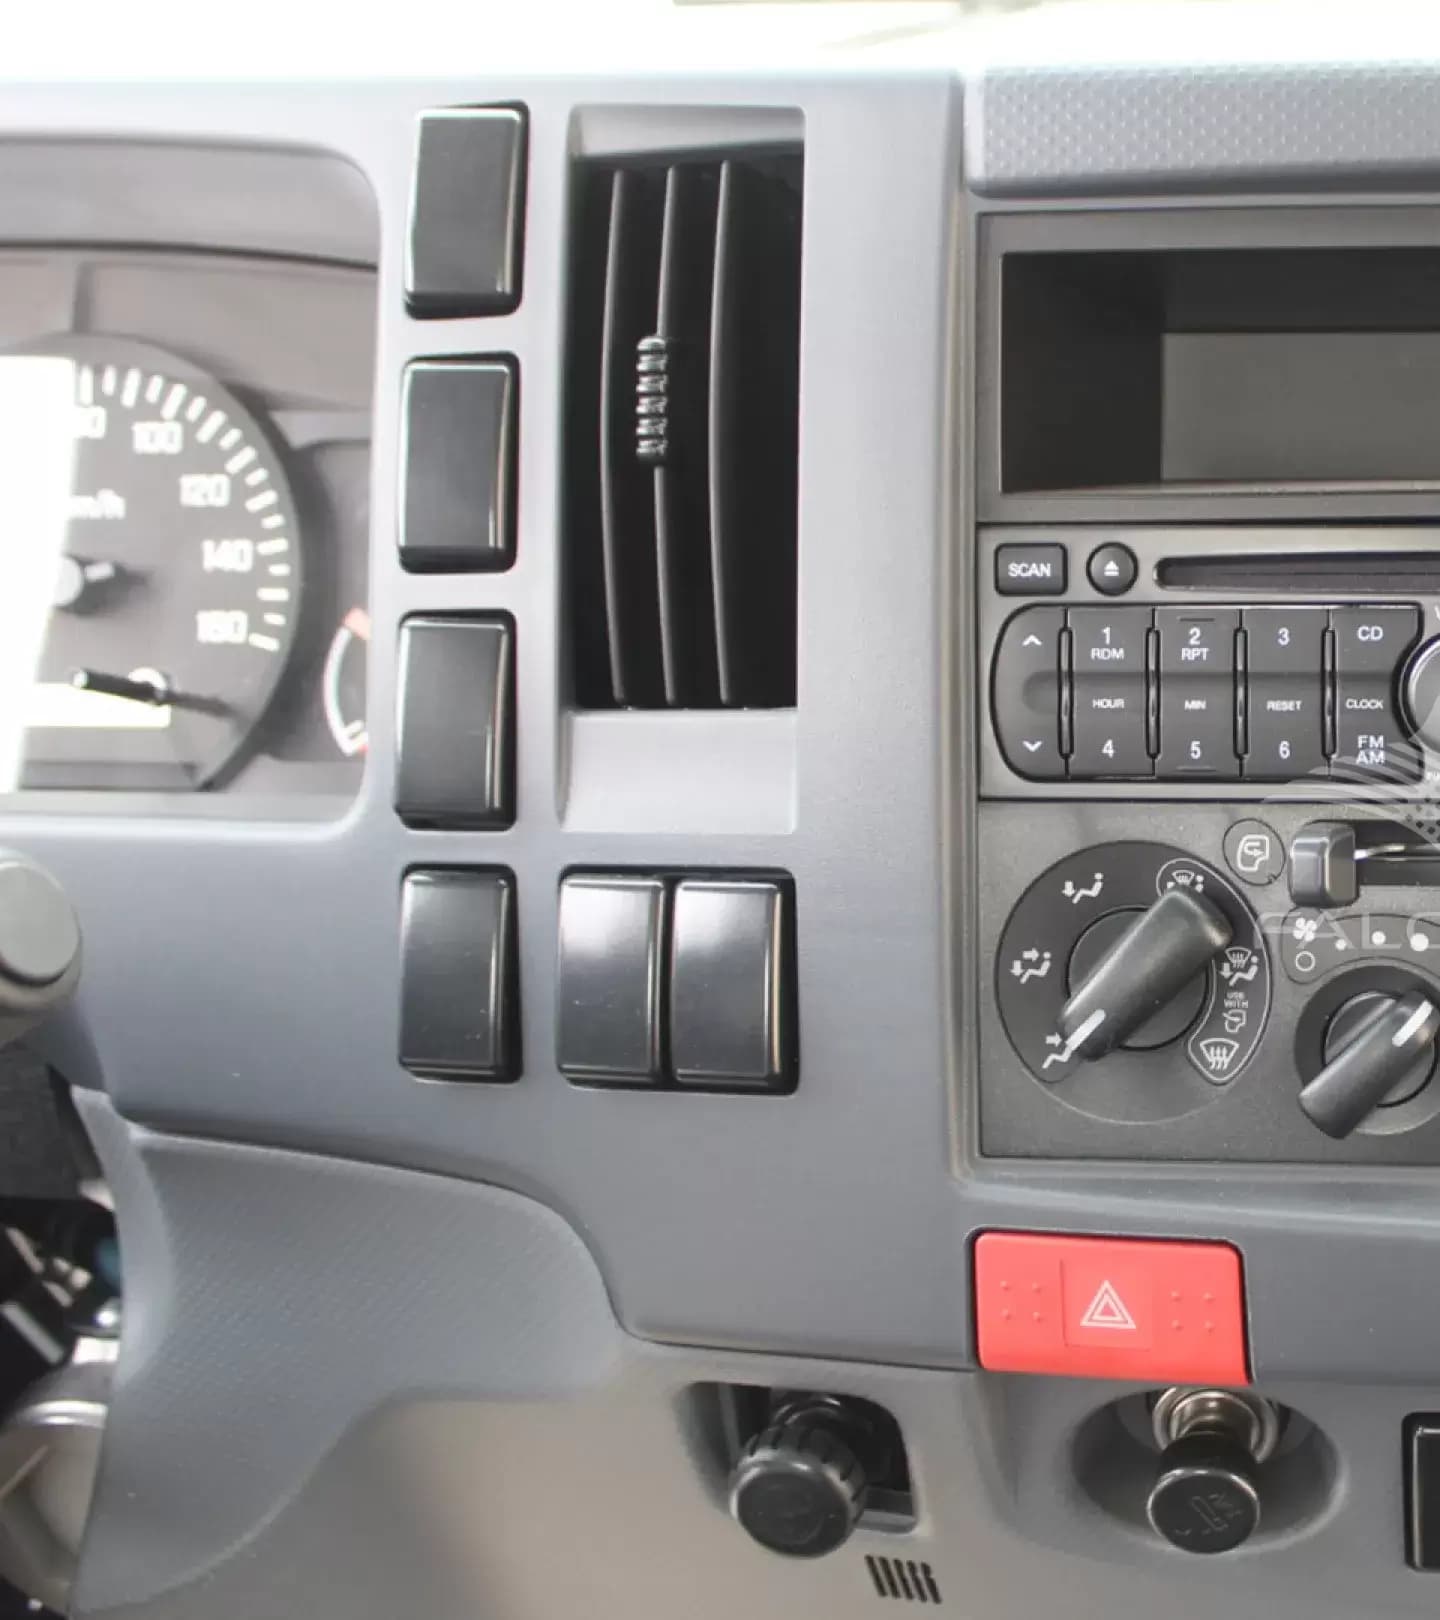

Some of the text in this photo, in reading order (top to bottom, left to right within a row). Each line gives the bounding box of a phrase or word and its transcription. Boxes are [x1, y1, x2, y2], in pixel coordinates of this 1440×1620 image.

[132, 421, 183, 454] 100
[180, 474, 231, 507] 120
[202, 538, 254, 572] 140
[1008, 562, 1051, 577] SCAN
[1102, 626, 1111, 645] 1
[1189, 627, 1201, 645] 2
[1278, 627, 1290, 646] 3
[1357, 625, 1384, 641] CD
[1090, 647, 1125, 660] RDM
[1181, 647, 1209, 661] RPT
[1092, 698, 1125, 709] HOUR
[1184, 700, 1207, 710] MIN
[1266, 700, 1302, 711] RESET
[1345, 698, 1384, 710] CLOCK
[1102, 739, 1115, 757] 4
[1190, 740, 1201, 760] 5
[1279, 740, 1291, 759] 6
[1356, 734, 1385, 750] FM
[1355, 750, 1386, 765] AM
